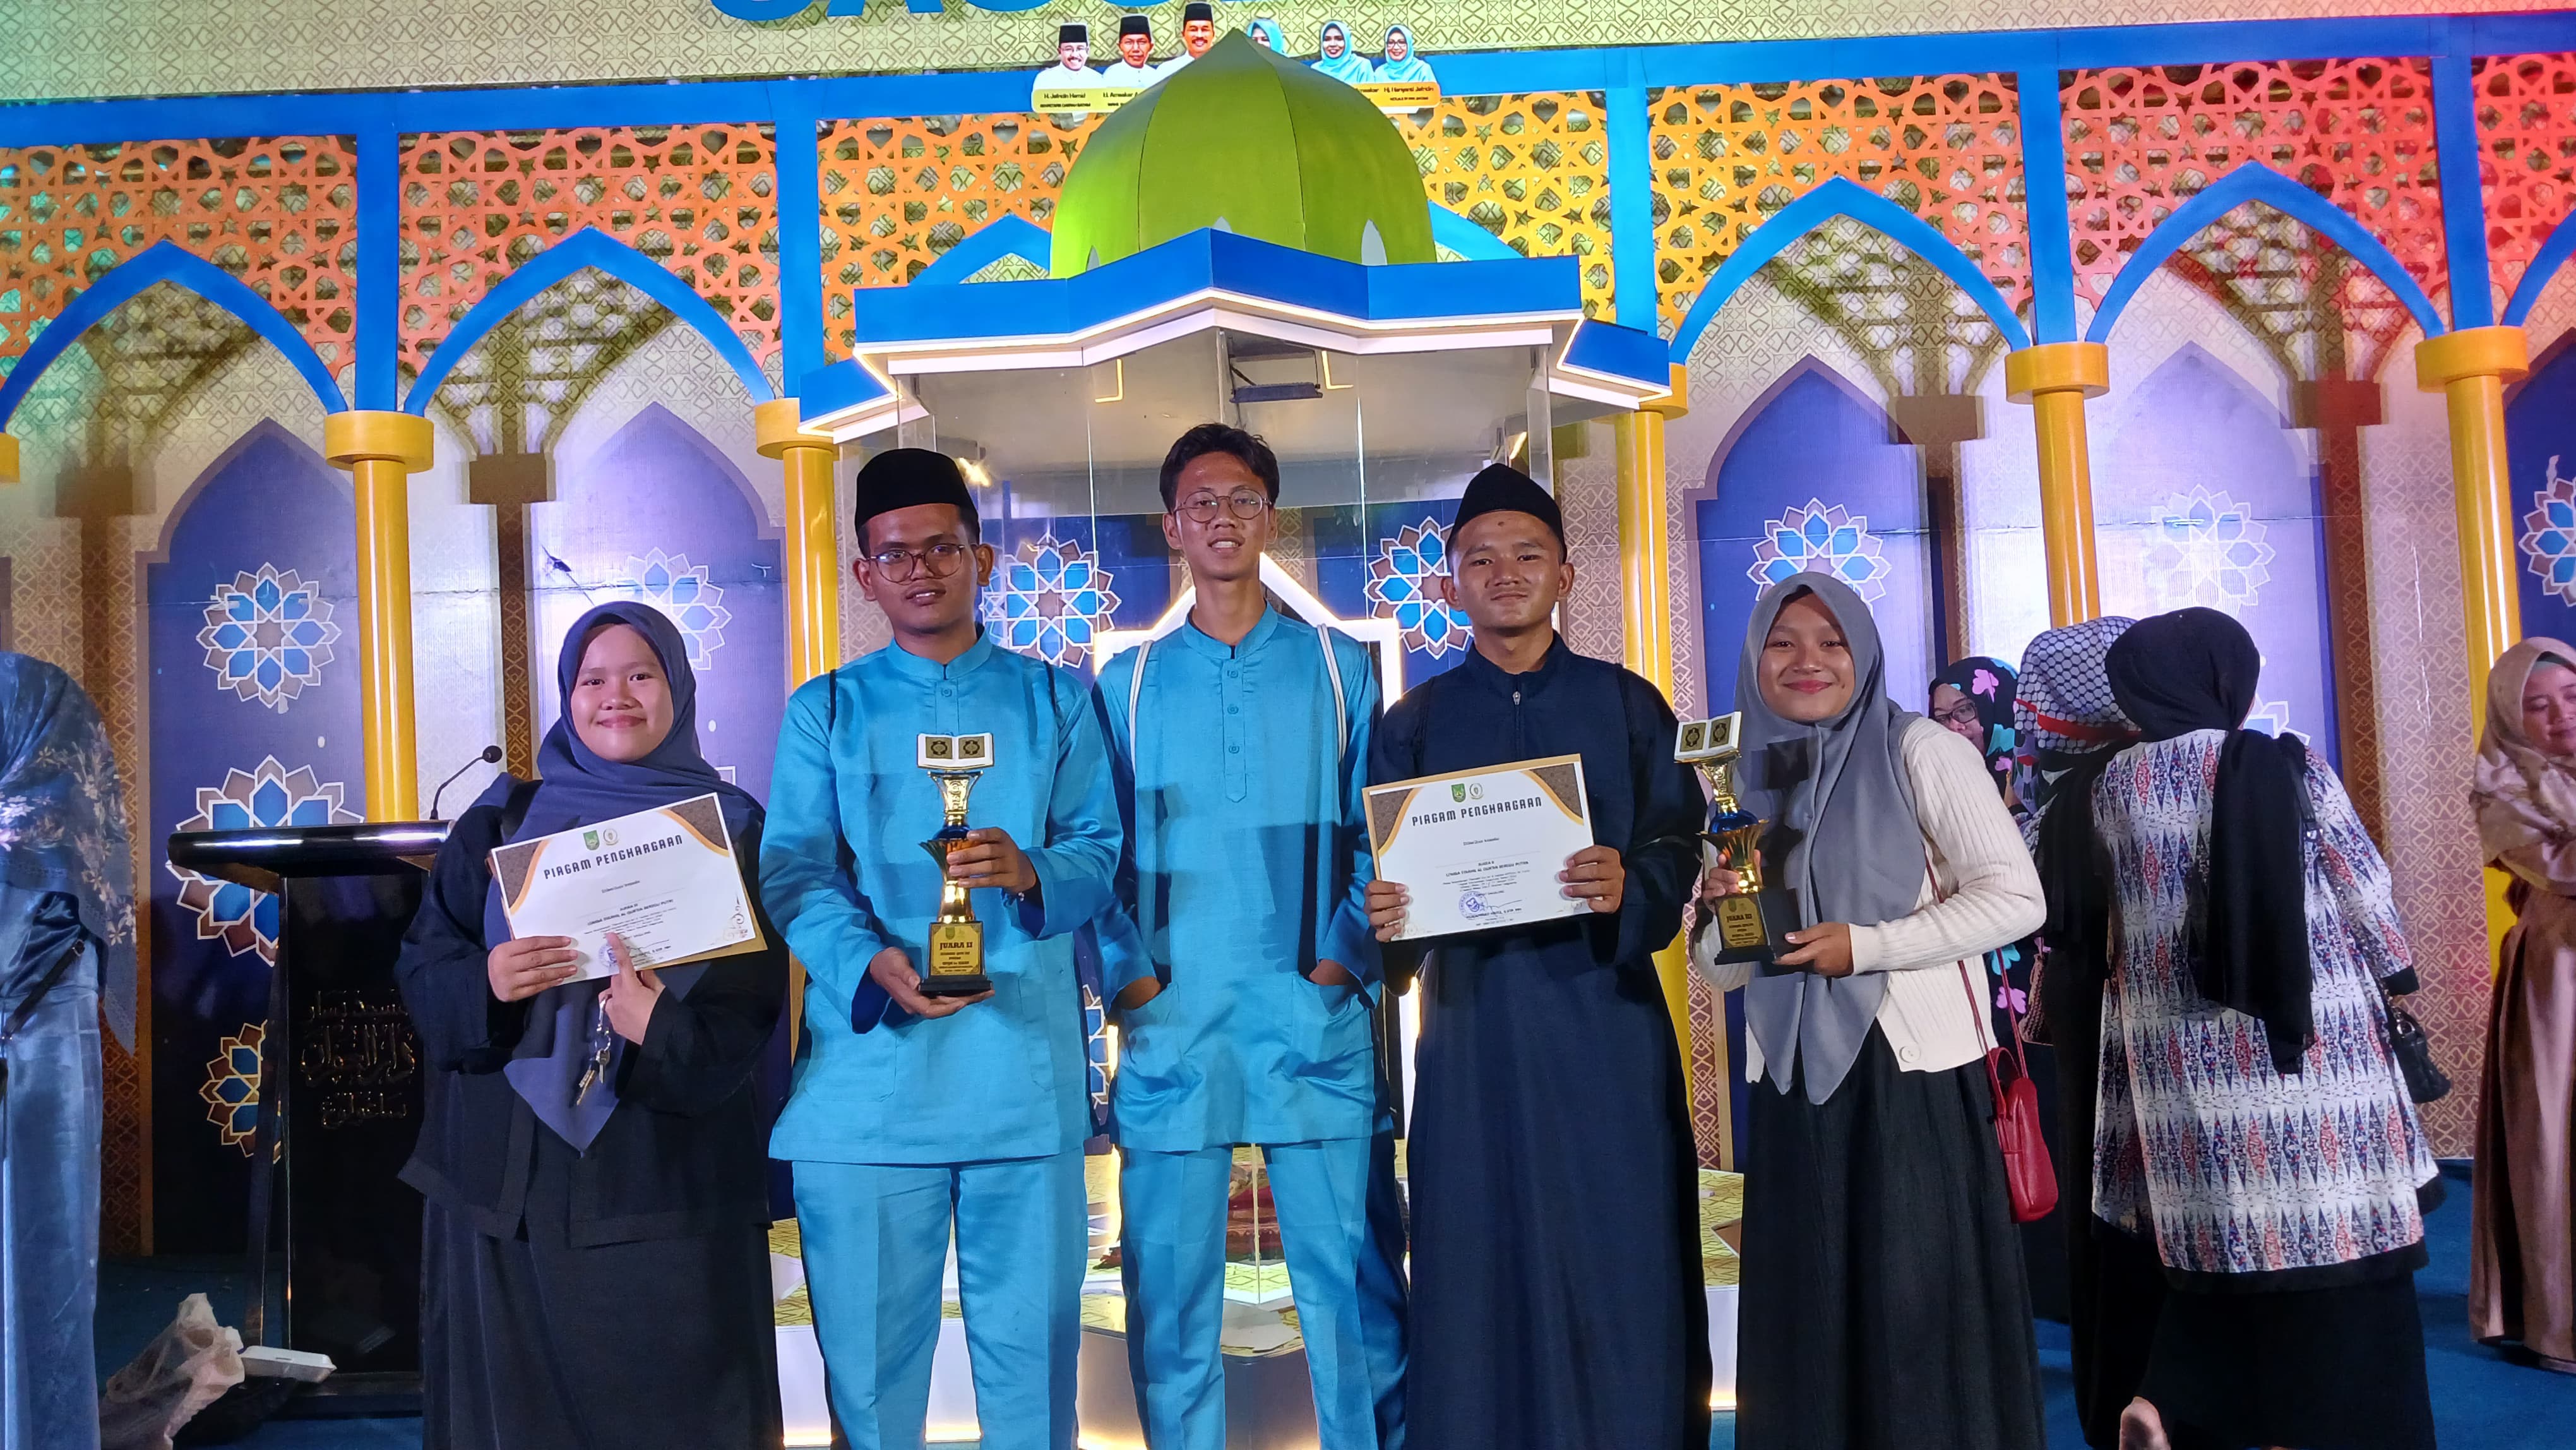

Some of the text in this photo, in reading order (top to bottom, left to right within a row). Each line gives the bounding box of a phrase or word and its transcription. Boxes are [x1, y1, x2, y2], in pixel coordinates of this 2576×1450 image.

[1412, 796, 1542, 826] PIAGAM PENGHARGAAN
[544, 834, 683, 880] PIAGAM PENGHARGAAN
[939, 942, 965, 950] JUARA
